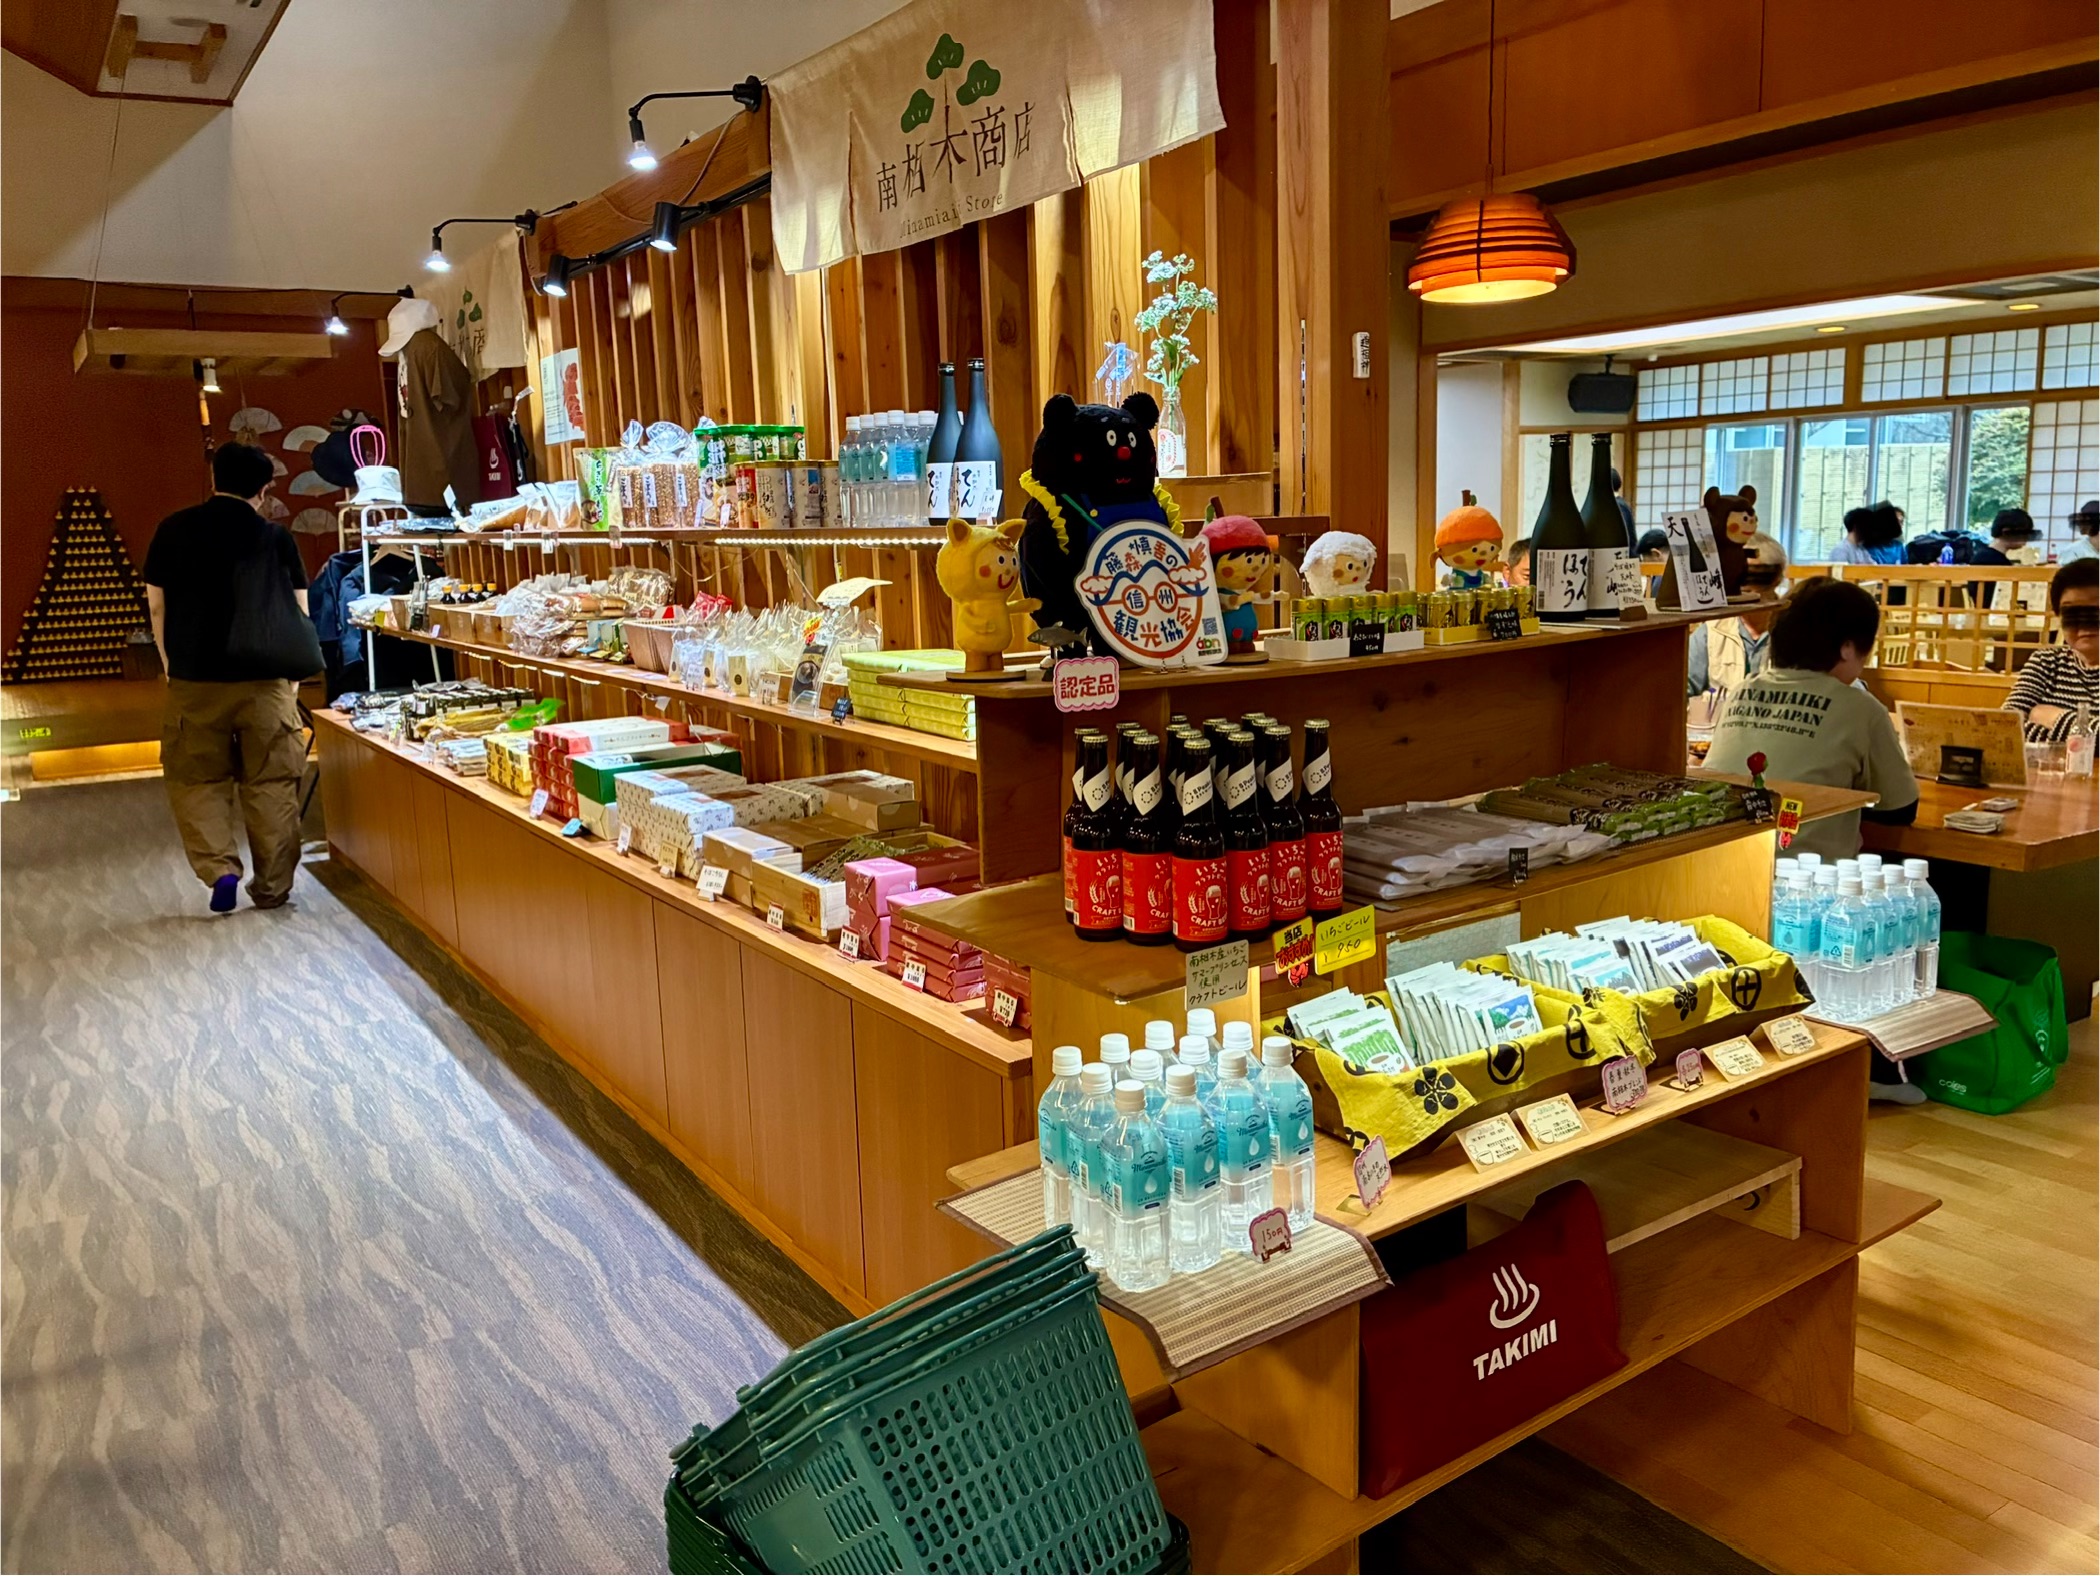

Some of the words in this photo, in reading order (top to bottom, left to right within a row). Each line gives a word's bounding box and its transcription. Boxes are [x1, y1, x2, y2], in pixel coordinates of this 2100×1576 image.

[966, 193, 1003, 212] Store
[1667, 516, 1684, 538] 天
[1103, 535, 1180, 575] 藤森慎吾の
[1126, 589, 1174, 610] 信州
[1114, 605, 1195, 649] 観光協会
[1060, 674, 1115, 699] 認定品
[1773, 708, 1824, 727] JAPAN
[1272, 895, 1298, 907] CRAFT
[1313, 886, 1337, 897] CRAFT
[1091, 905, 1117, 916] CRAFT
[1242, 905, 1266, 916] CRAFT
[1190, 915, 1217, 927] CRAFT
[1320, 915, 1370, 941] いちごビール
[1284, 924, 1303, 944] 当店
[1337, 939, 1361, 958] 950
[1189, 980, 1248, 1005] クラフトビール
[1938, 1079, 1968, 1093] coles
[1262, 1227, 1284, 1243] 150円
[1472, 1319, 1558, 1381] TAKIMI
